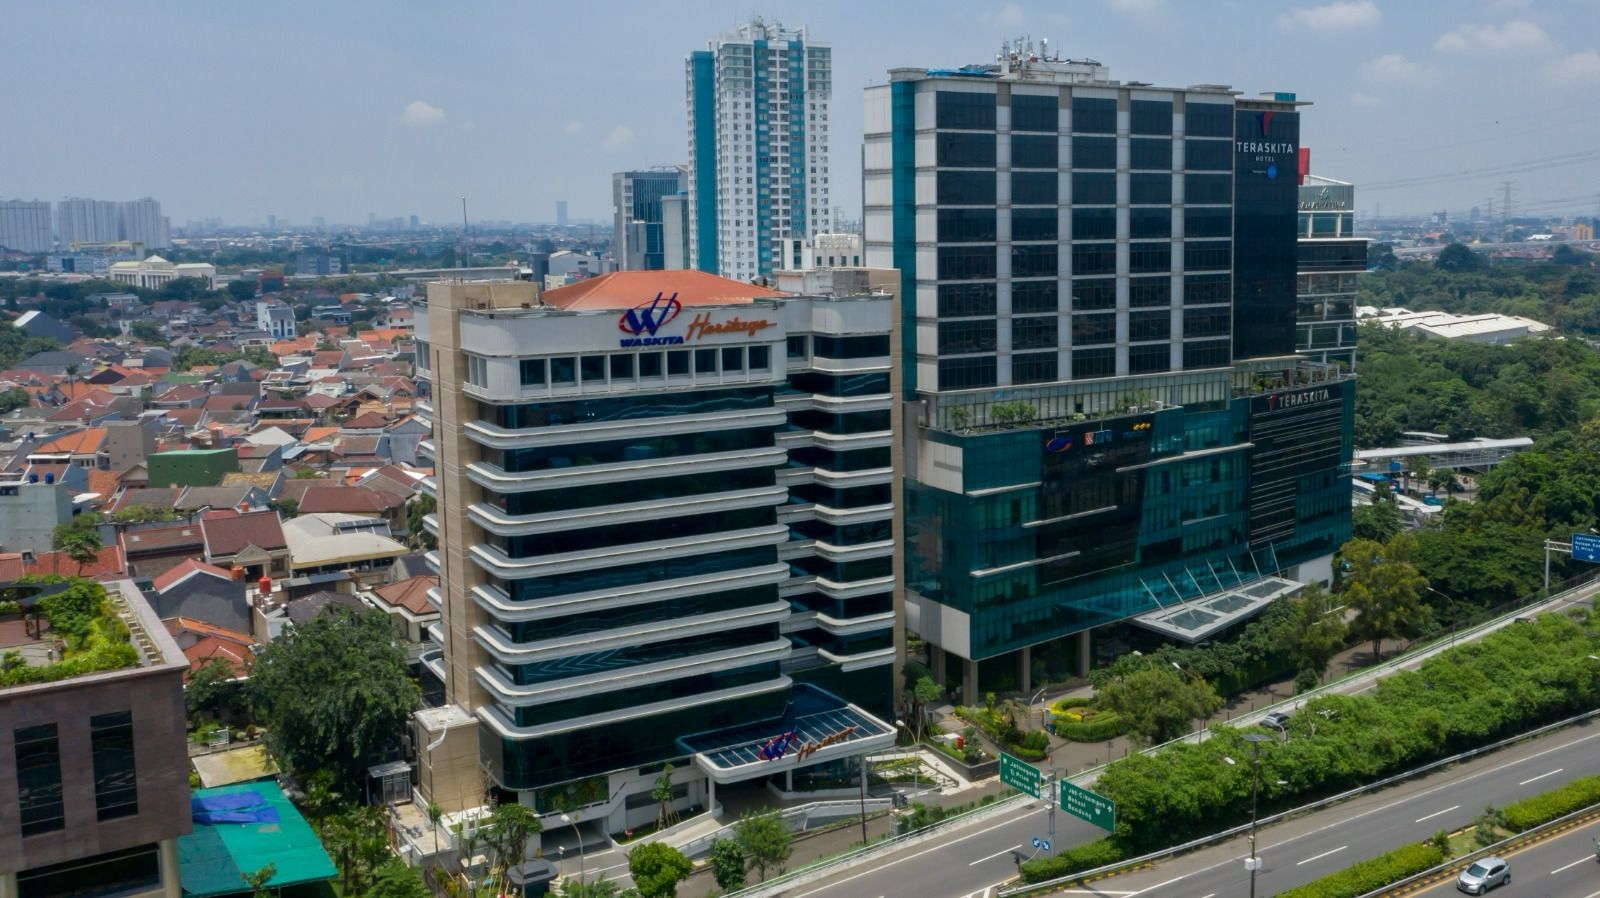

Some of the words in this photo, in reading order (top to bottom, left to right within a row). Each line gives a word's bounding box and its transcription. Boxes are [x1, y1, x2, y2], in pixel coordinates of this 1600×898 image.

[1237, 142, 1293, 153] TERASKITA
[686, 312, 777, 341] Heritage
[620, 336, 684, 347] WASKITA
[1279, 389, 1329, 409] TERASKITA
